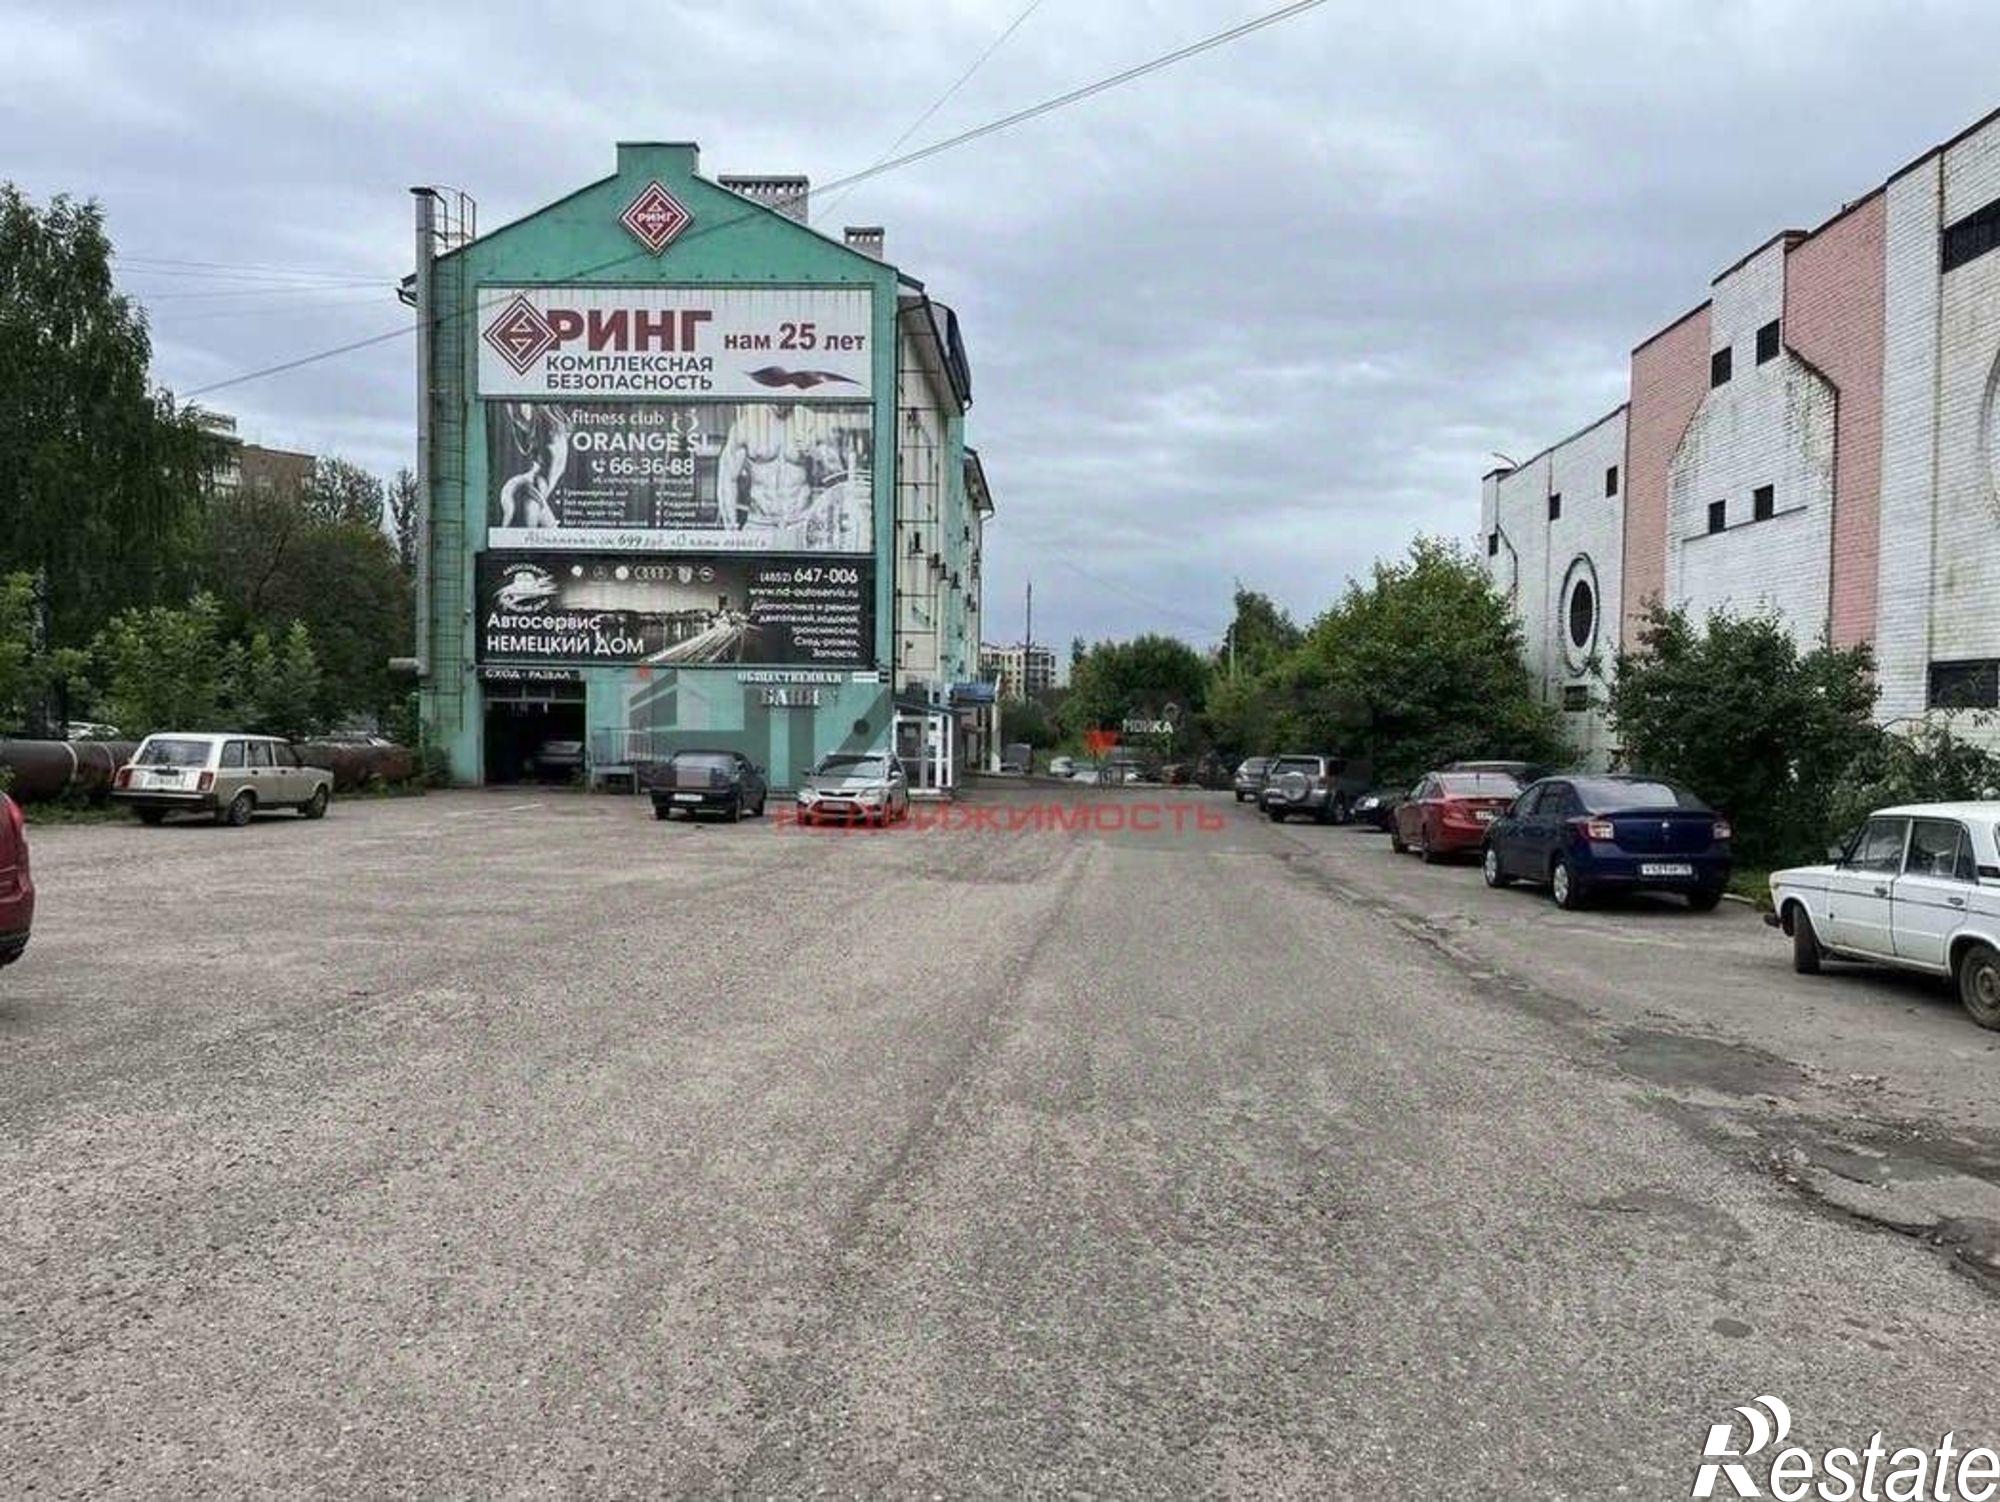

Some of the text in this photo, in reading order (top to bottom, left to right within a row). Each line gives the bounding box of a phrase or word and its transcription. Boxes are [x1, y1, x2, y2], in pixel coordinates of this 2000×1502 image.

[546, 309, 713, 352] РИНГ
[725, 323, 866, 351] нам 25 лет
[546, 356, 713, 373] КОМПЛЕКСНАЯ
[546, 373, 713, 391] БЕЗОПАСНОСТЬ
[571, 409, 665, 425] fitness club
[572, 431, 681, 452] ORANGE
[794, 567, 859, 584] 647-006
[487, 612, 602, 633] Автосервис
[487, 632, 645, 656] НЕМЕЦКИЙ ДОМ
